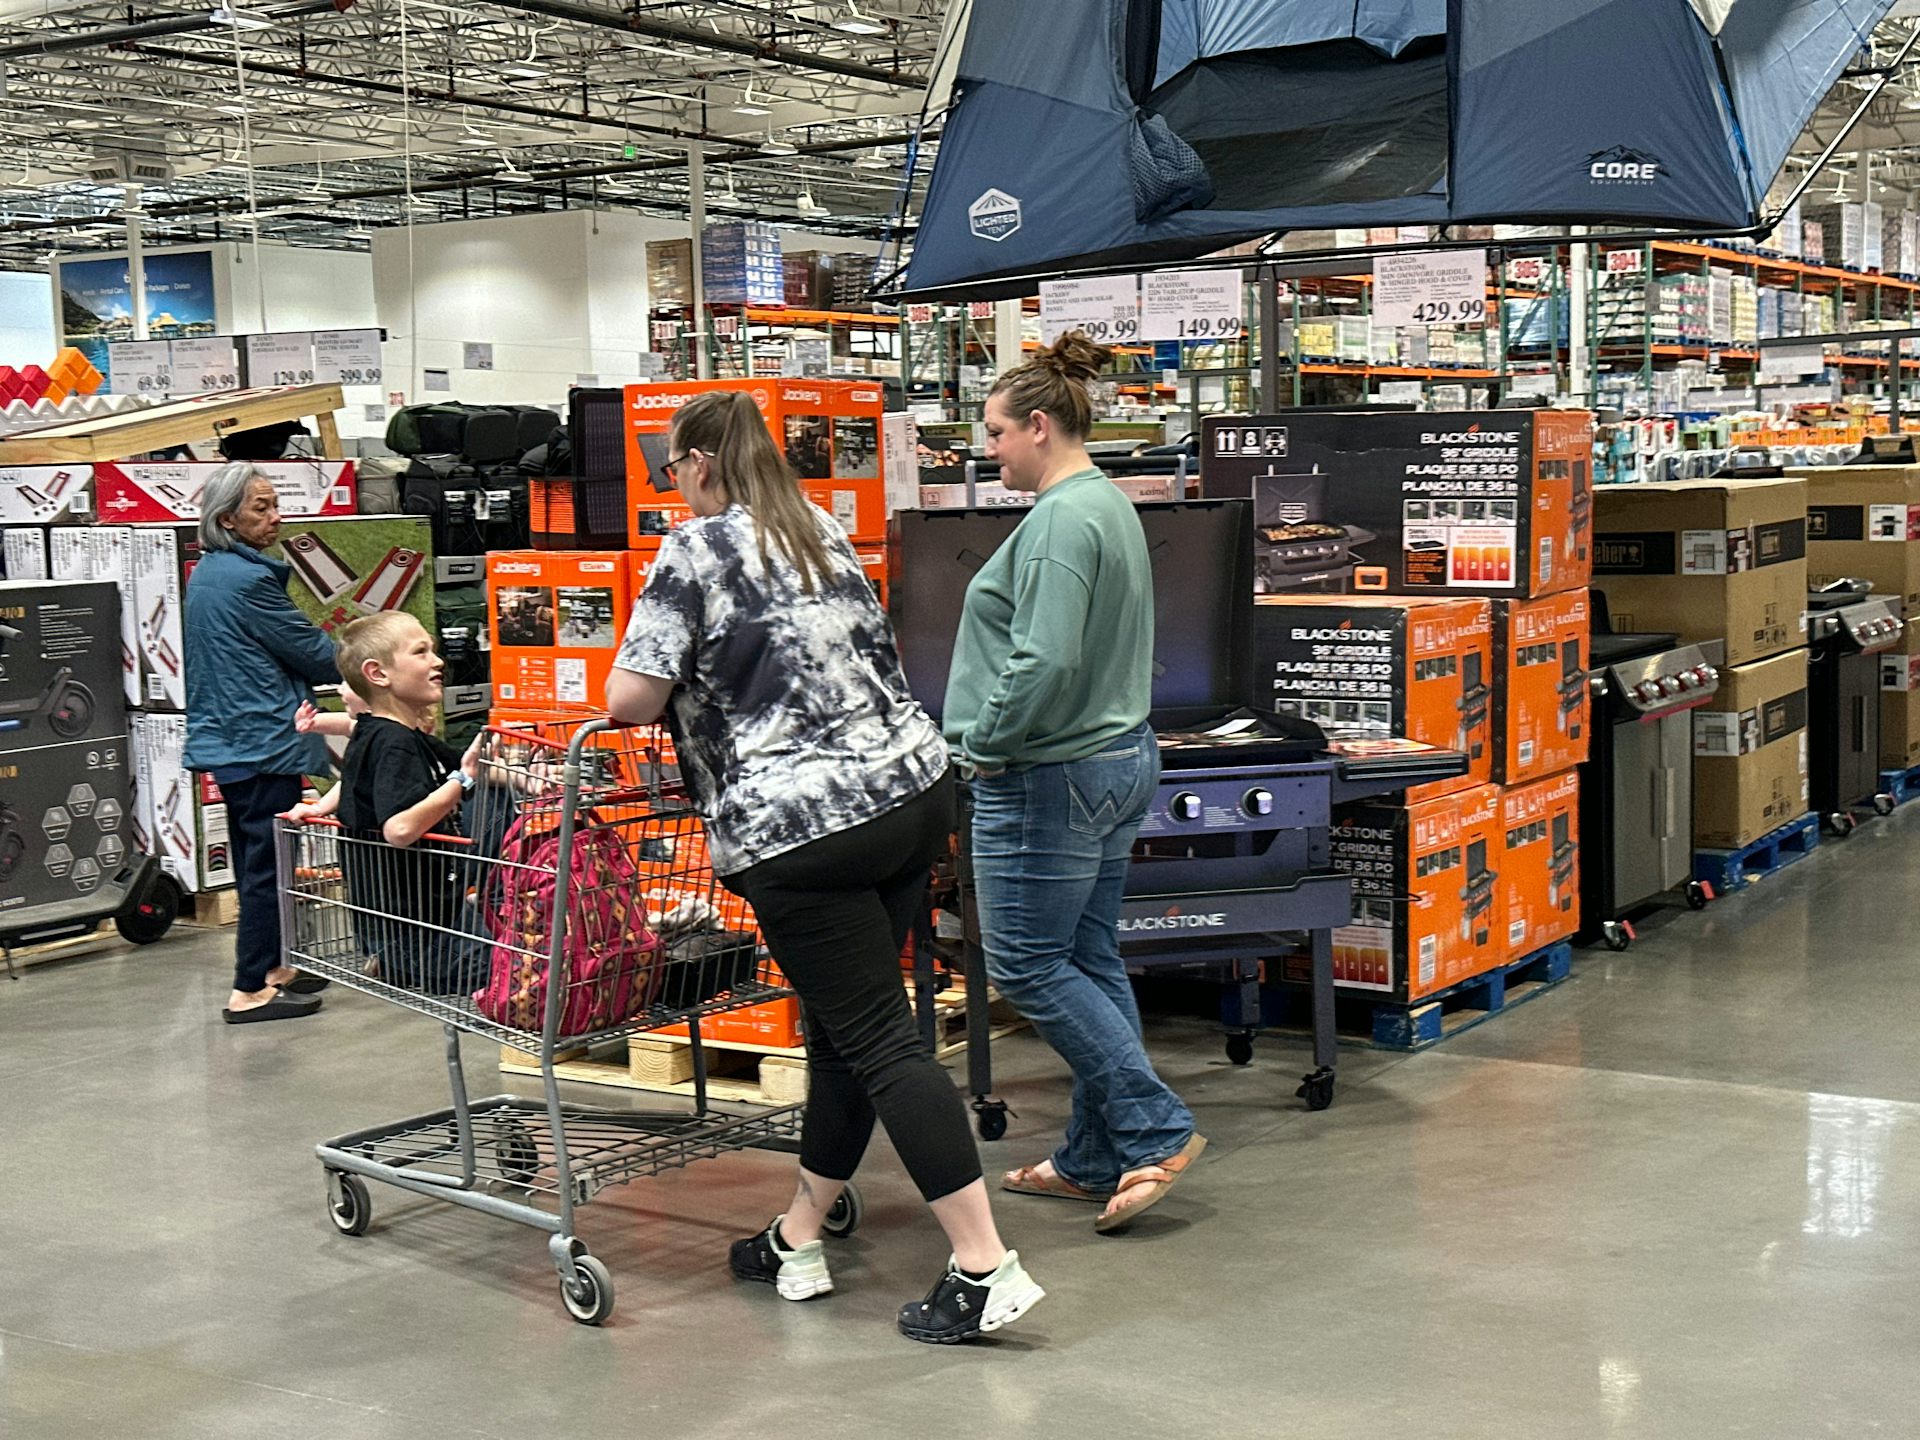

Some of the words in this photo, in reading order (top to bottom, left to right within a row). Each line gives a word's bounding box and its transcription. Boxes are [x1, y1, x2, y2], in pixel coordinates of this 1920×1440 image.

[1590, 162, 1656, 179] CORE
[975, 213, 1017, 227] LIGHTED
[987, 225, 1007, 234] TENT
[1610, 252, 1636, 270] 304
[1381, 264, 1426, 273] BLACKSTONE
[1436, 268, 1468, 276] GRIDDLE
[1389, 278, 1417, 286] HINGED
[1418, 276, 1438, 284] HOOD
[1413, 300, 1484, 321] 429.99
[1178, 317, 1240, 337] 149.99
[201, 374, 236, 390] 89.99
[273, 369, 314, 385] 129.99
[340, 368, 382, 385] 399.99
[782, 388, 822, 405] Jackery
[1421, 432, 1520, 444] BLACKSTONE
[1462, 447, 1518, 458] GRIDDLE
[1406, 464, 1457, 476] PLAQUE
[1458, 465, 1478, 475] DE
[1479, 465, 1498, 475] 36
[1499, 465, 1519, 475] PO
[1402, 481, 1464, 492] PLANCHA
[1465, 481, 1484, 491] DE
[1485, 481, 1504, 491] 36
[1505, 481, 1519, 491] in
[1594, 541, 1627, 564] eber
[493, 562, 541, 577] Jackery
[1291, 629, 1393, 641] BLACKSTONE
[1312, 645, 1334, 655] 36"
[1334, 645, 1392, 657] GRIDDLE
[1276, 662, 1330, 673] PLAQUE
[1331, 663, 1350, 673] DE
[1351, 663, 1370, 674] 36
[1371, 664, 1393, 674] PO
[1273, 679, 1337, 690] PLANCHA
[1338, 681, 1358, 691] DE
[1360, 681, 1378, 691] 36
[1379, 682, 1392, 692] in
[1461, 809, 1496, 827] BLACKSTONE
[1328, 825, 1393, 840] CKSTONE
[1338, 842, 1393, 855] GRIDDLE
[1334, 859, 1352, 870] DE
[1354, 861, 1372, 871] 36
[1374, 862, 1394, 873] PO
[1116, 913, 1226, 931] BLACKSTONE
